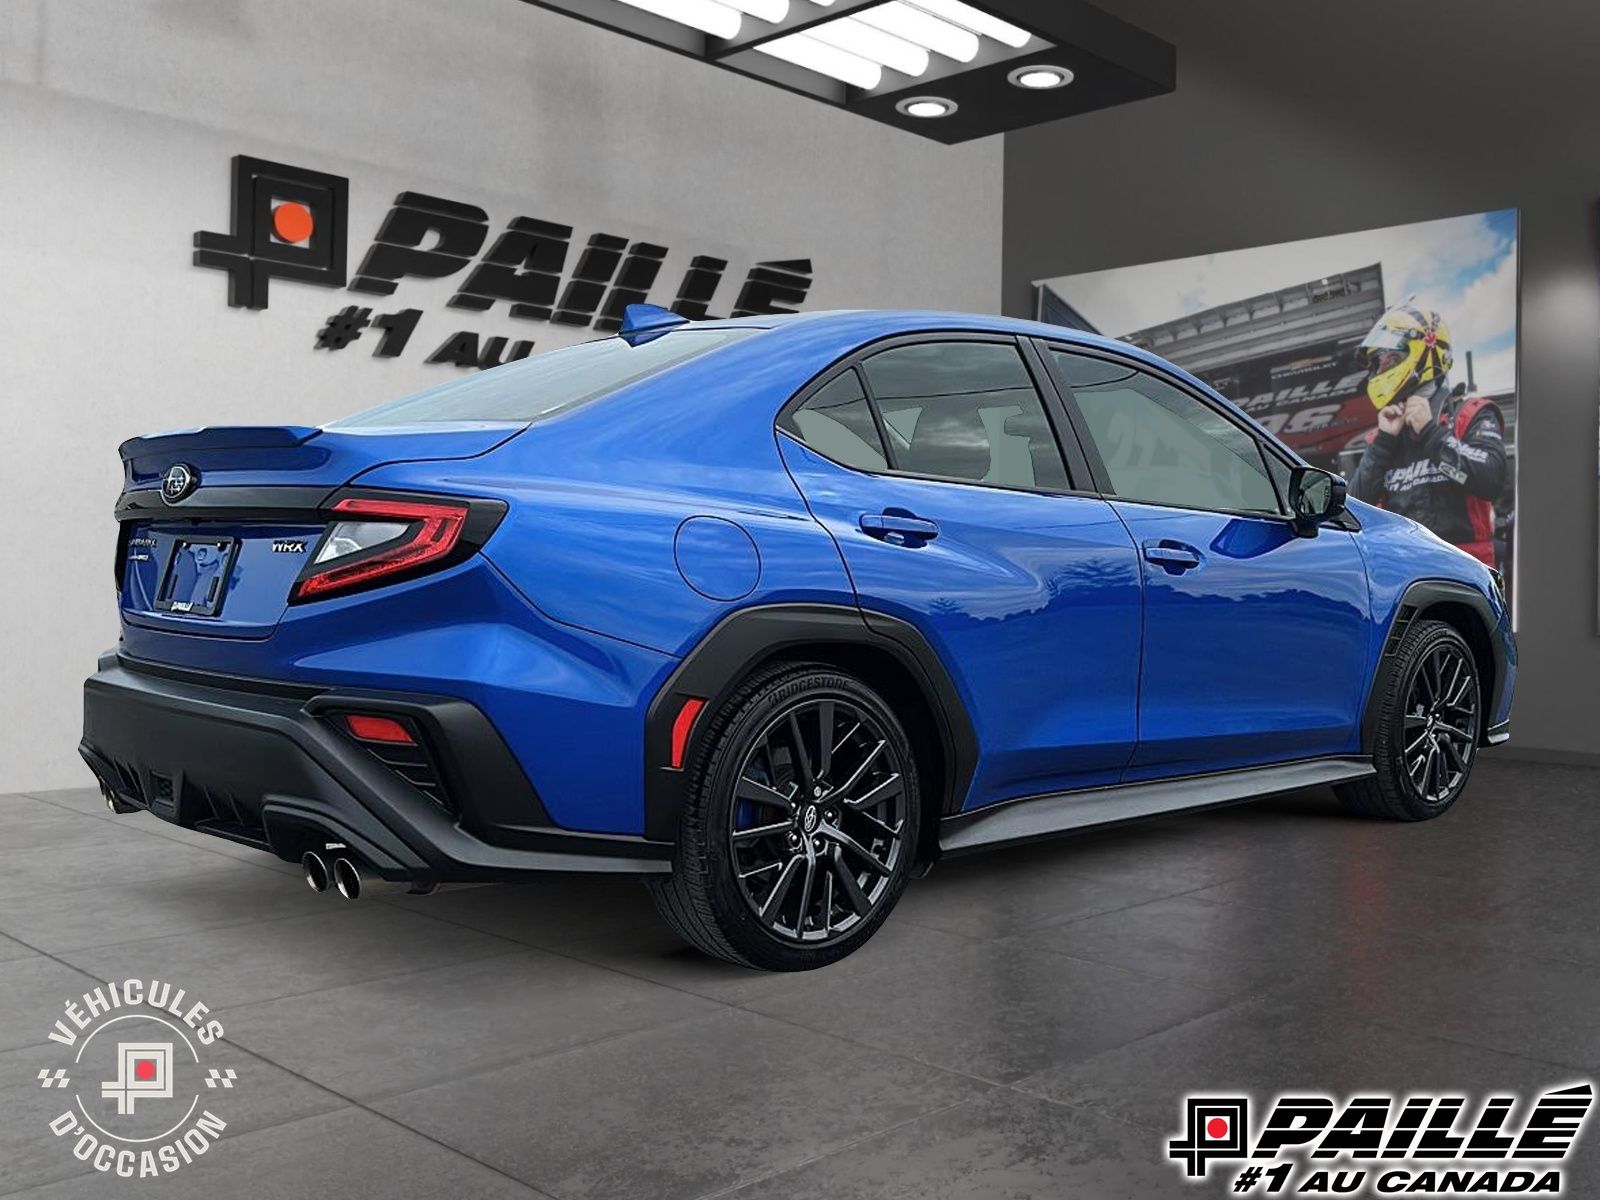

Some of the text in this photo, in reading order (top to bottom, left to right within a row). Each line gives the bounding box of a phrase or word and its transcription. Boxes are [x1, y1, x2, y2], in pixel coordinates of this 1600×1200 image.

[347, 190, 813, 331] PAILLÉ
[313, 305, 535, 370] #1 AU
